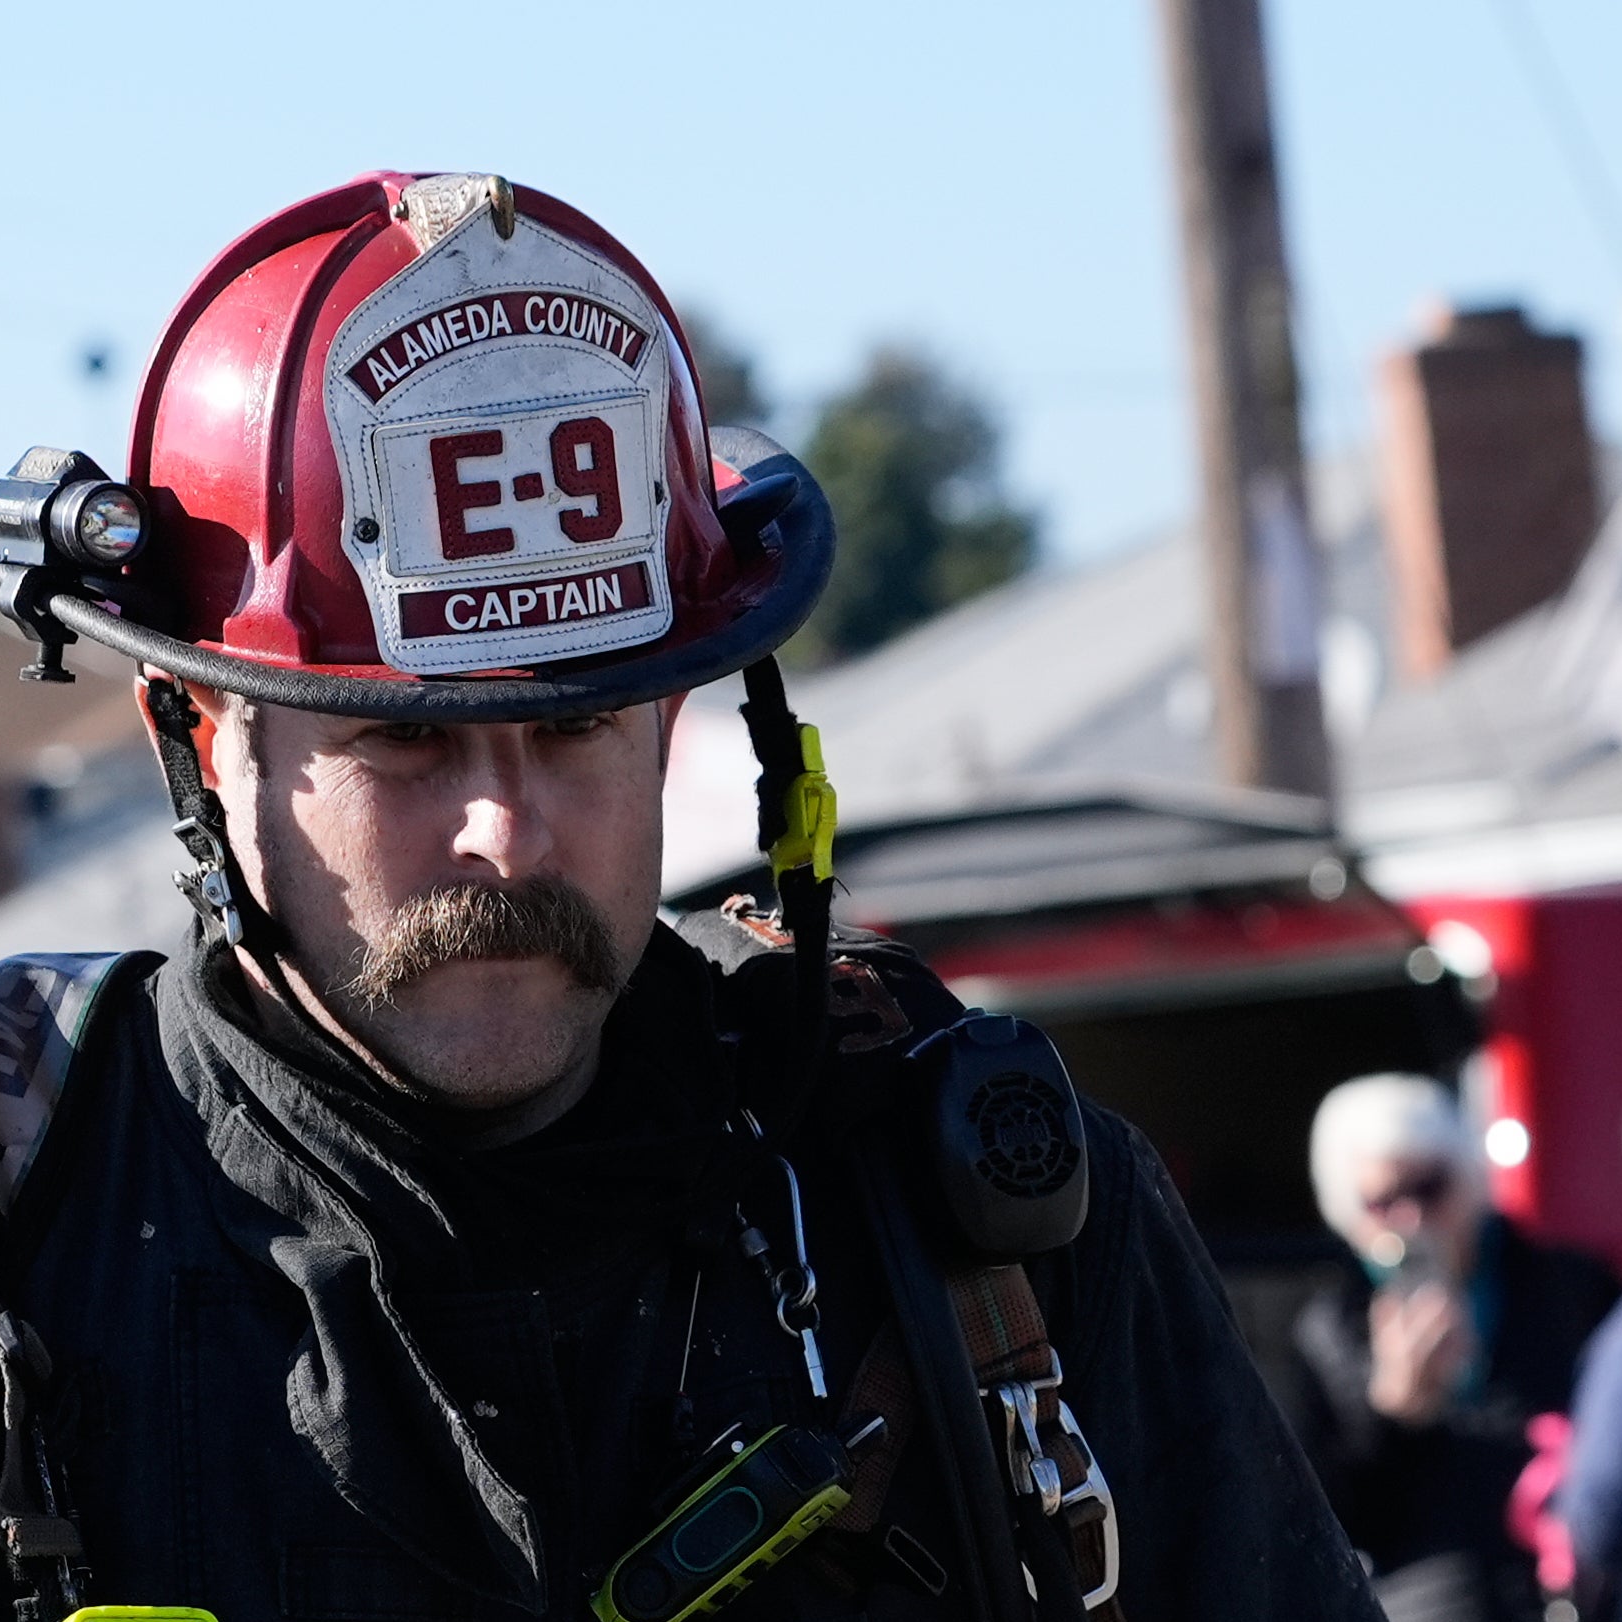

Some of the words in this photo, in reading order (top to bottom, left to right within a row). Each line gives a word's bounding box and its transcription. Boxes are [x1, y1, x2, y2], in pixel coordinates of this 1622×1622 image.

[366, 299, 513, 393] ALAMEDA
[523, 295, 638, 362] COUNTY
[429, 416, 625, 562] E-9
[443, 573, 624, 632] CAPTAIN
